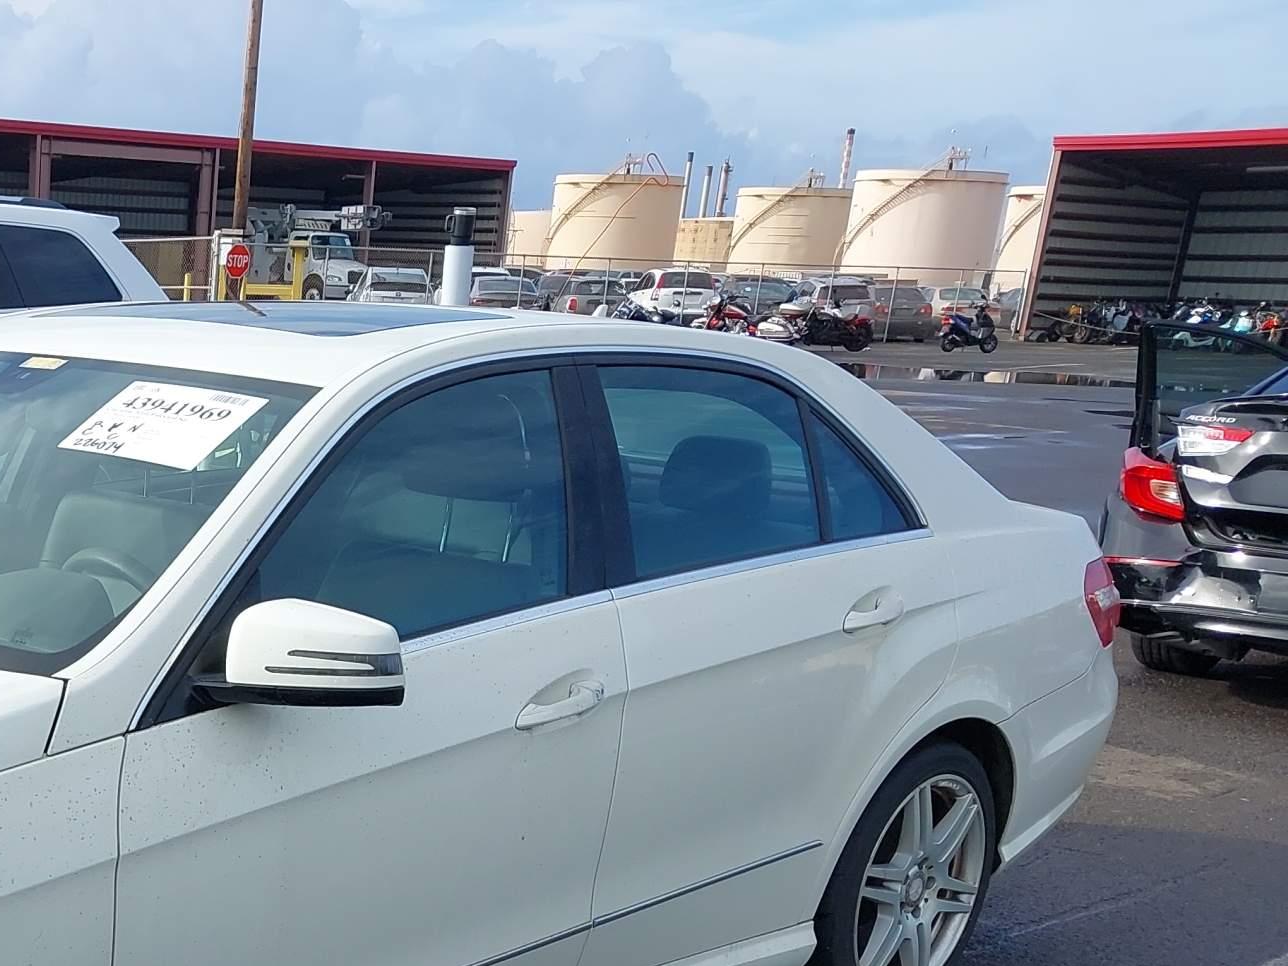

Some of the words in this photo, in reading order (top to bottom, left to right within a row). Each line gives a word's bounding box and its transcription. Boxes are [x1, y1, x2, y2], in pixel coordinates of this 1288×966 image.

[227, 254, 249, 268] STOP
[122, 396, 232, 421] 43941969
[1185, 415, 1237, 423] ACCORD
